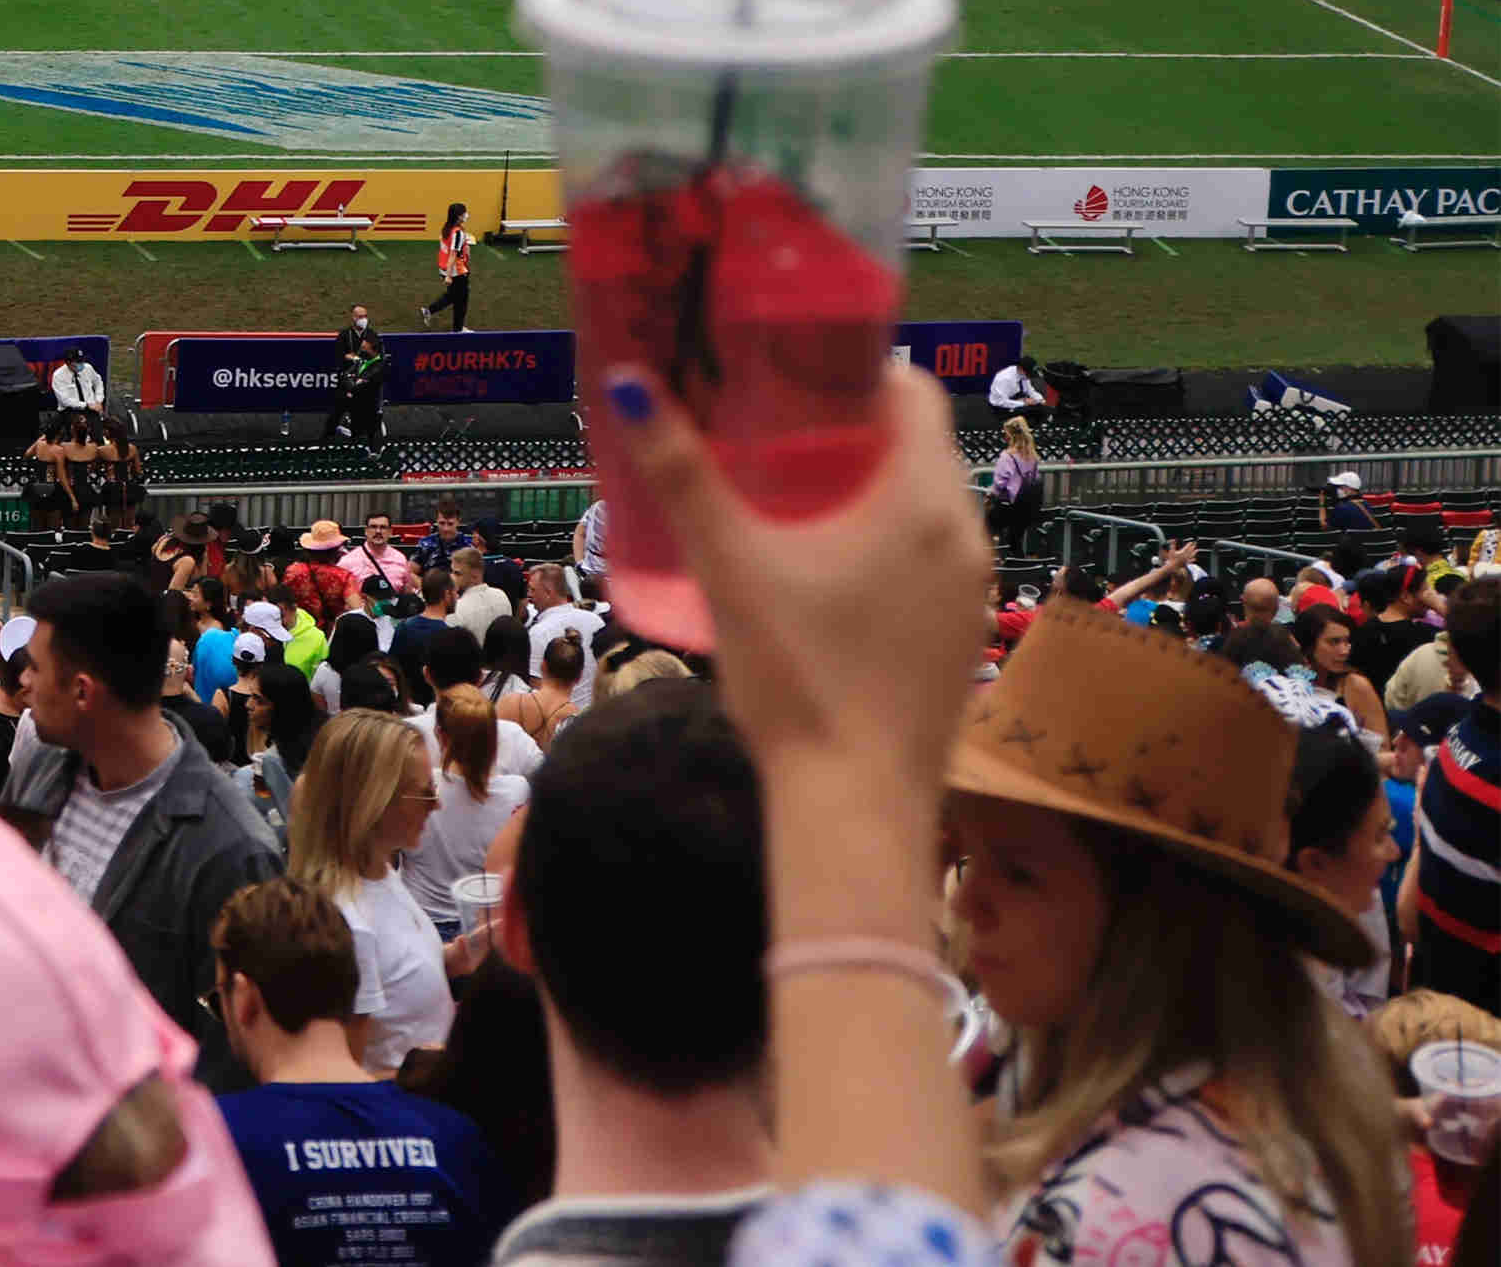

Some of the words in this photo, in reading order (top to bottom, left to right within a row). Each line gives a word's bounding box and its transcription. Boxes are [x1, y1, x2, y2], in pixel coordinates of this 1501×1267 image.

[915, 187, 952, 199] HONG
[956, 187, 994, 199] KONG
[1113, 187, 1148, 199] HONG
[1152, 187, 1190, 199] KONG
[1286, 190, 1426, 216] CATHAY
[117, 180, 367, 232] DHL
[915, 200, 953, 209] TOURISM
[956, 200, 993, 209] BOARD
[1113, 200, 1150, 209] TOURISM
[1153, 200, 1188, 209] BOARD
[414, 350, 537, 372] #OURHK7s
[934, 344, 988, 376] OUR
[212, 367, 339, 389] @hksevens
[284, 1142, 300, 1172] I
[302, 1137, 437, 1170] SURVIVED
